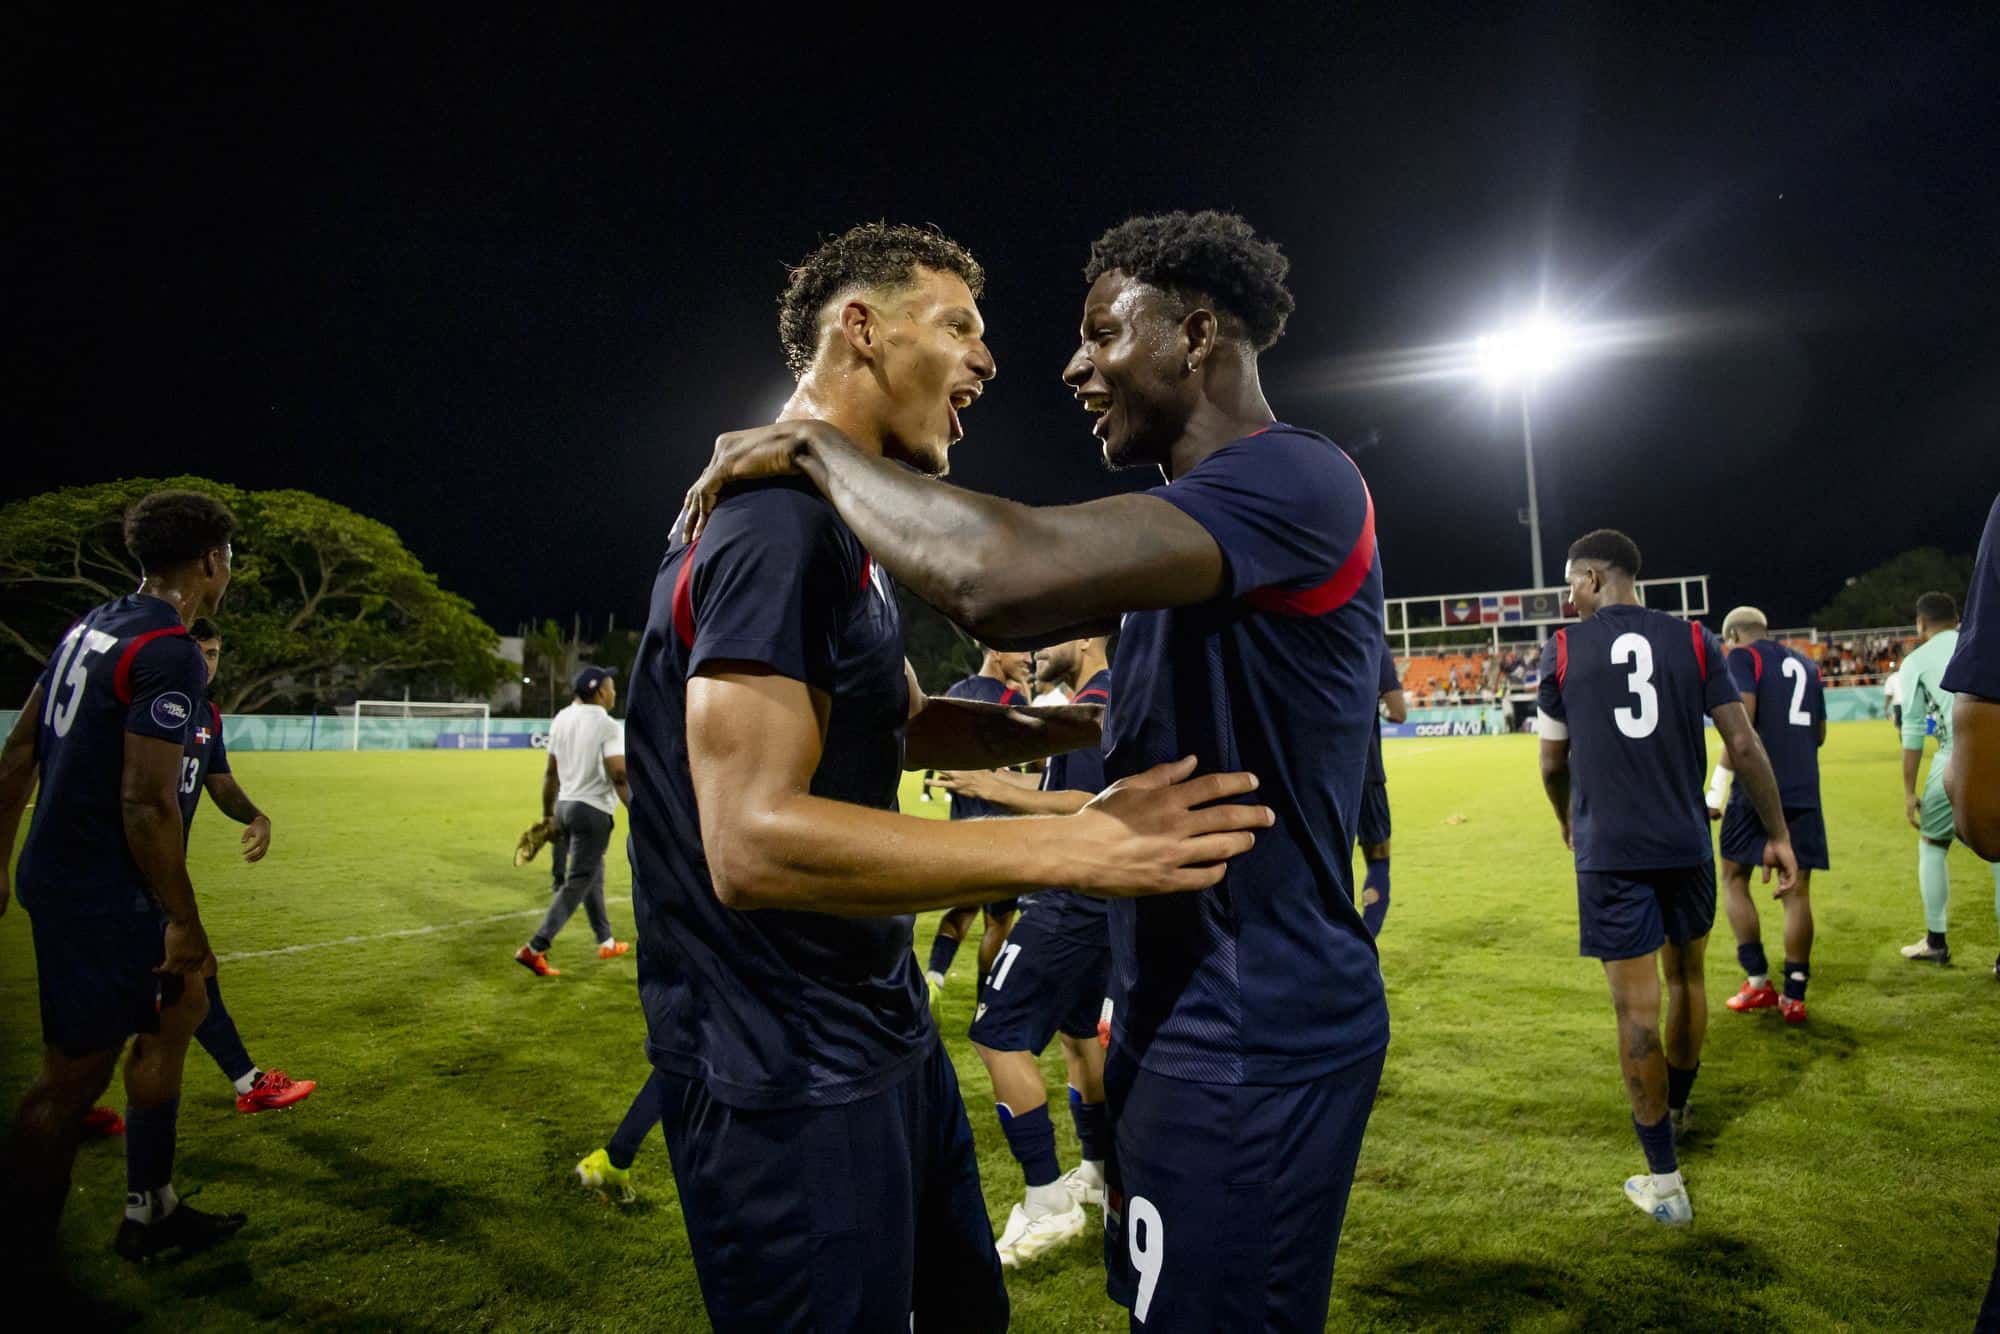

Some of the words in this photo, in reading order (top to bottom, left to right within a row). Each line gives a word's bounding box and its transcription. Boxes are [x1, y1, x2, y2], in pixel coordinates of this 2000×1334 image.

[44, 624, 119, 738] 15
[1610, 632, 1659, 739] 3
[1782, 656, 1811, 727] 2
[180, 756, 200, 794] 13
[1128, 1195, 1164, 1324] 9
